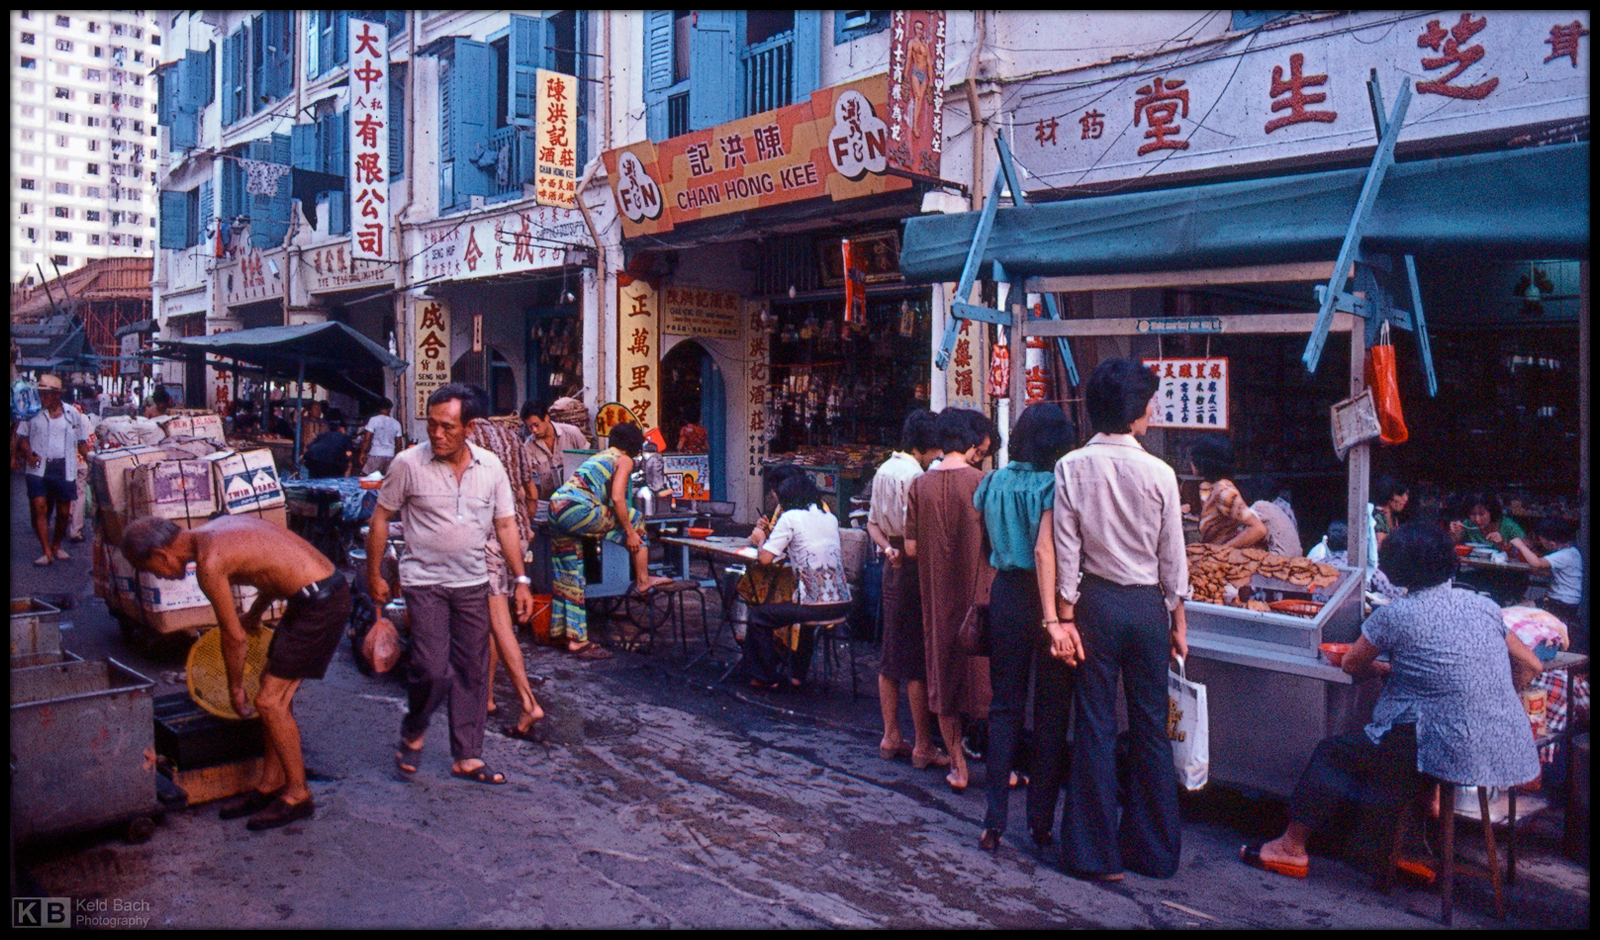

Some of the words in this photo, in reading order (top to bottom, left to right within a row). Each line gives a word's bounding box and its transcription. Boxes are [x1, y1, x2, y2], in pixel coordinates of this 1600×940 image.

[354, 23, 385, 257] 大中私人有限公司
[833, 129, 887, 167] F&N
[540, 165, 552, 175] CHAN
[553, 167, 565, 177] HONG
[566, 170, 574, 179] KEE
[620, 183, 657, 213] F&N
[677, 184, 721, 211] CHAN
[725, 172, 774, 200] HONG
[781, 163, 818, 190] KEE
[431, 248, 444, 260] SENG
[446, 244, 456, 257] HUP
[418, 302, 446, 359] 成合
[418, 373, 434, 381] SENG
[435, 373, 448, 381] HUP
[173, 419, 188, 428] NEW
[228, 488, 250, 499] TWIN
[254, 481, 278, 492] PEAKS
